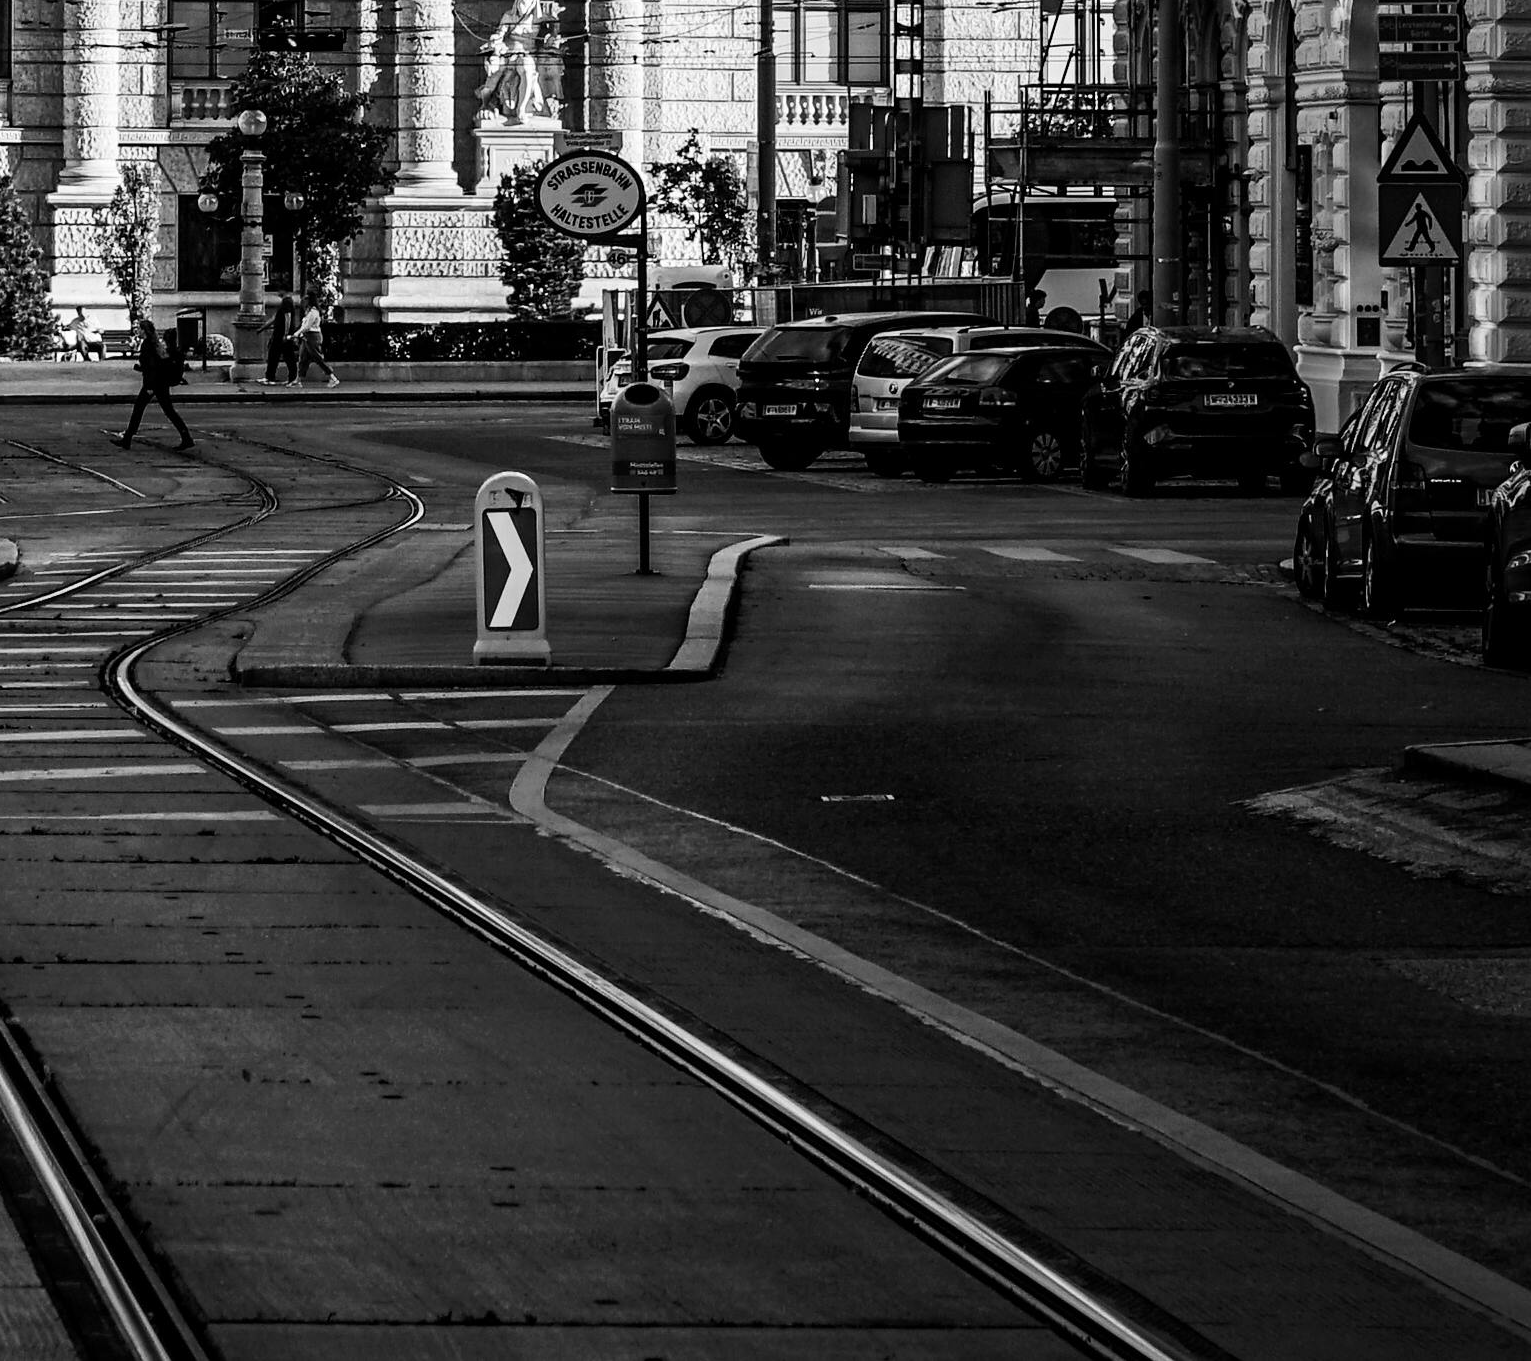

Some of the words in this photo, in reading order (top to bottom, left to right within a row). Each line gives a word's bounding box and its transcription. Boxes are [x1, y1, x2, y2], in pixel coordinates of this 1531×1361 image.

[547, 161, 632, 191] STRASSENBAHN
[550, 203, 629, 229] HALTESTELLE
[609, 253, 626, 265] 46
